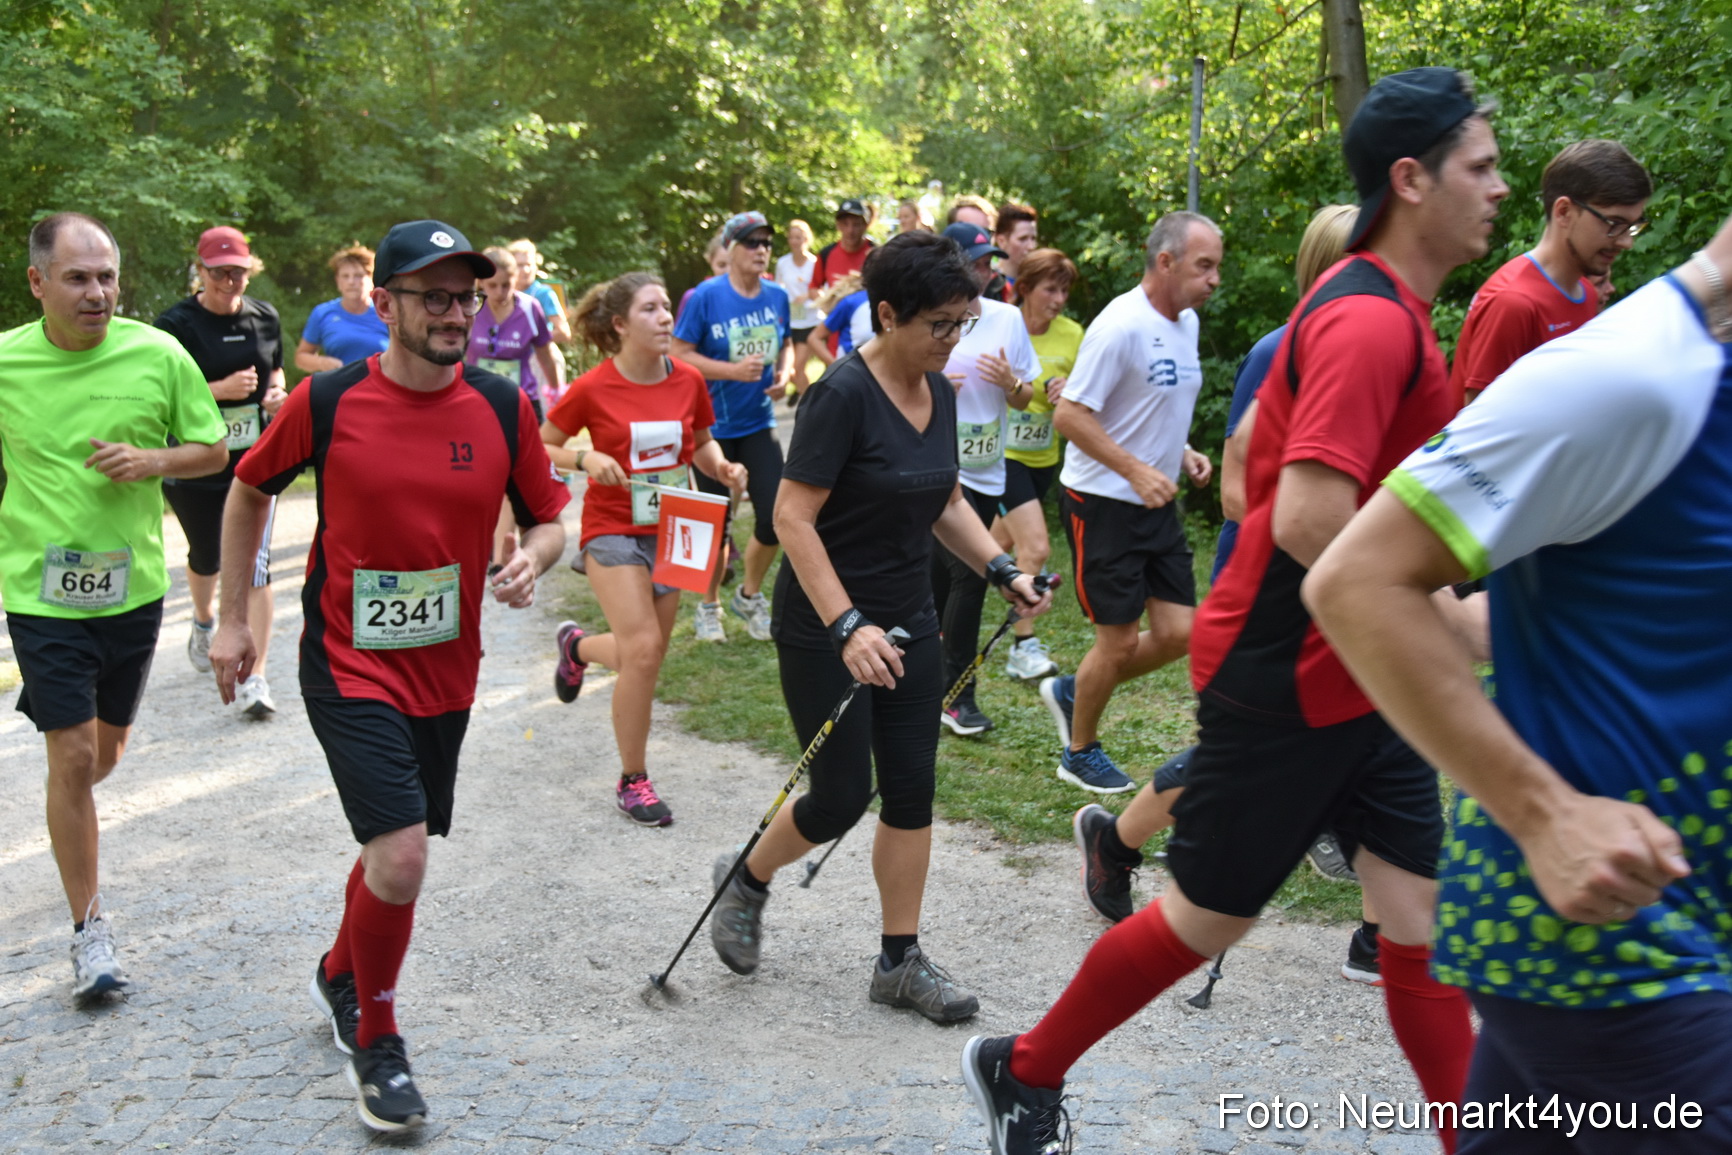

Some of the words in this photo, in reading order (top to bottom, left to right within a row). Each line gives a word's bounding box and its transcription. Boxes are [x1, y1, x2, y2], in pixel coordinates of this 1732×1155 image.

[737, 340, 772, 356] 2037
[1013, 425, 1050, 440] 1248
[449, 441, 473, 462] 13
[61, 571, 112, 594] 664
[367, 595, 444, 627] 2341
